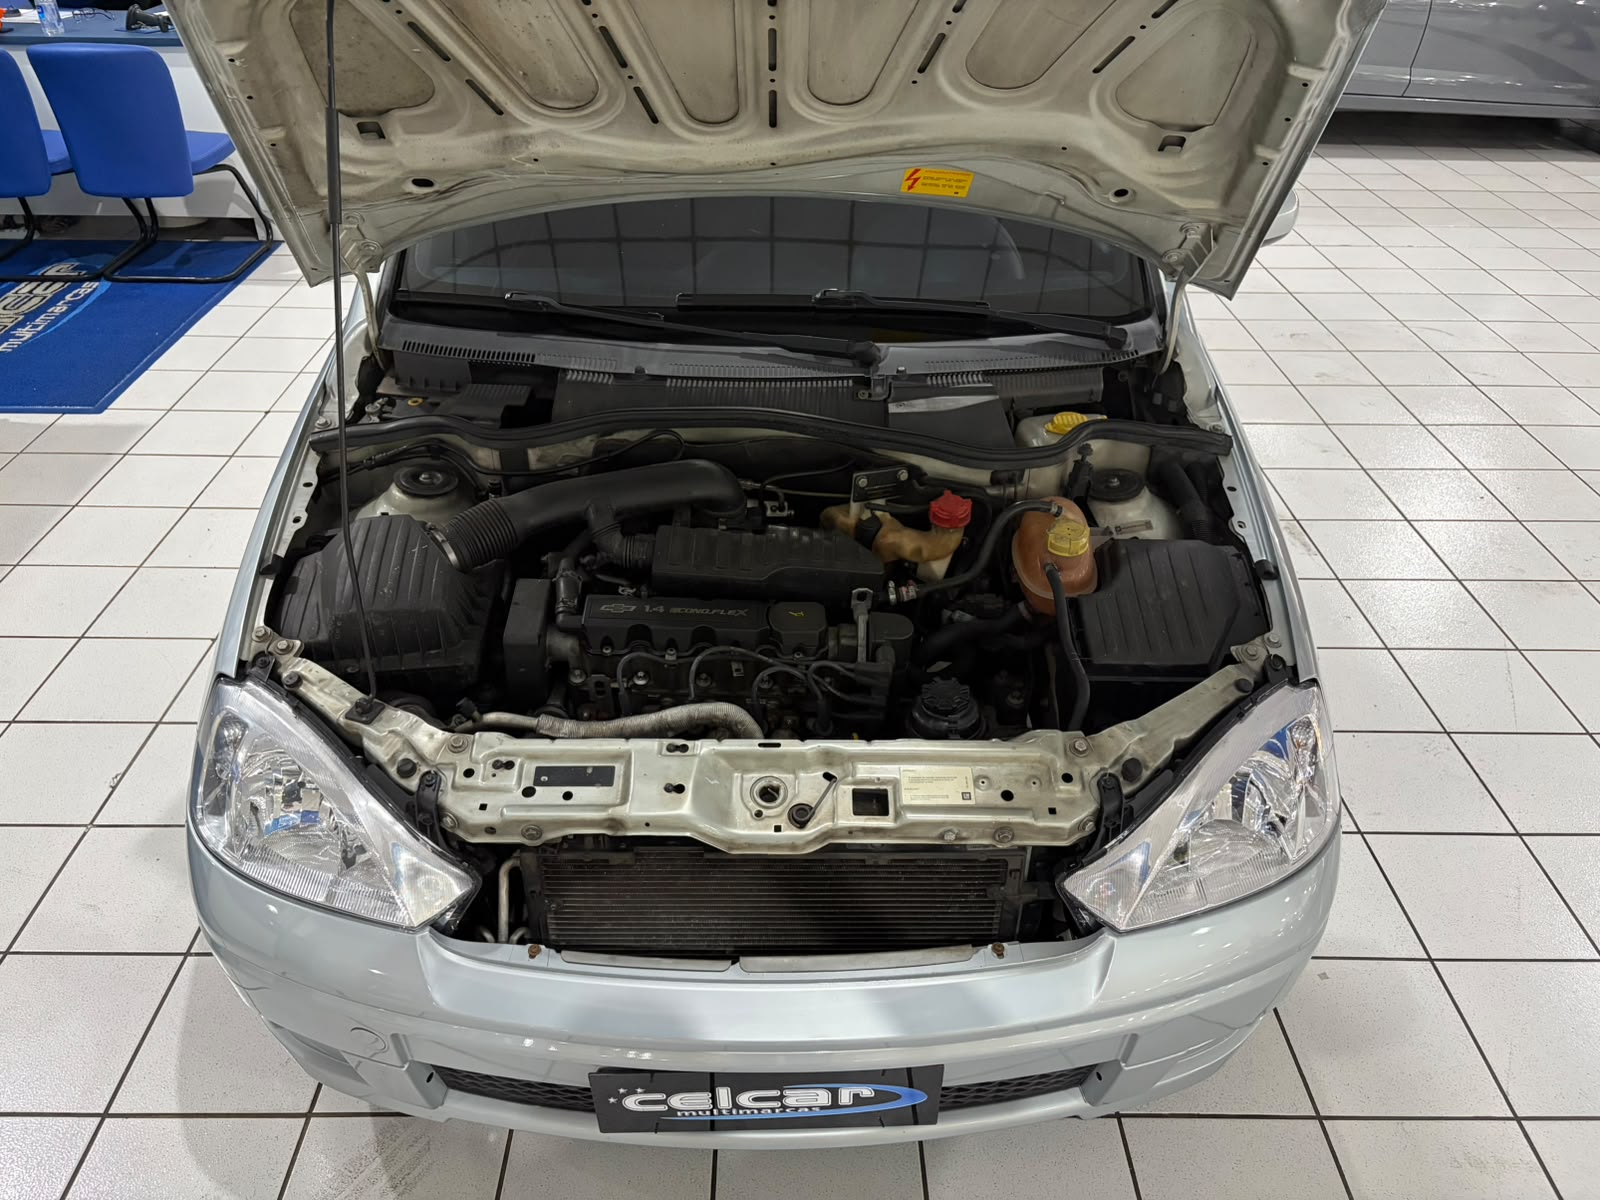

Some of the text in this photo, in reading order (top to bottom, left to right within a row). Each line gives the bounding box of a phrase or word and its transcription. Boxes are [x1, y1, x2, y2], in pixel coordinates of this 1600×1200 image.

[644, 605, 664, 613] 1.4
[622, 1086, 875, 1112] celcar
[677, 1106, 821, 1117] multimarcas
